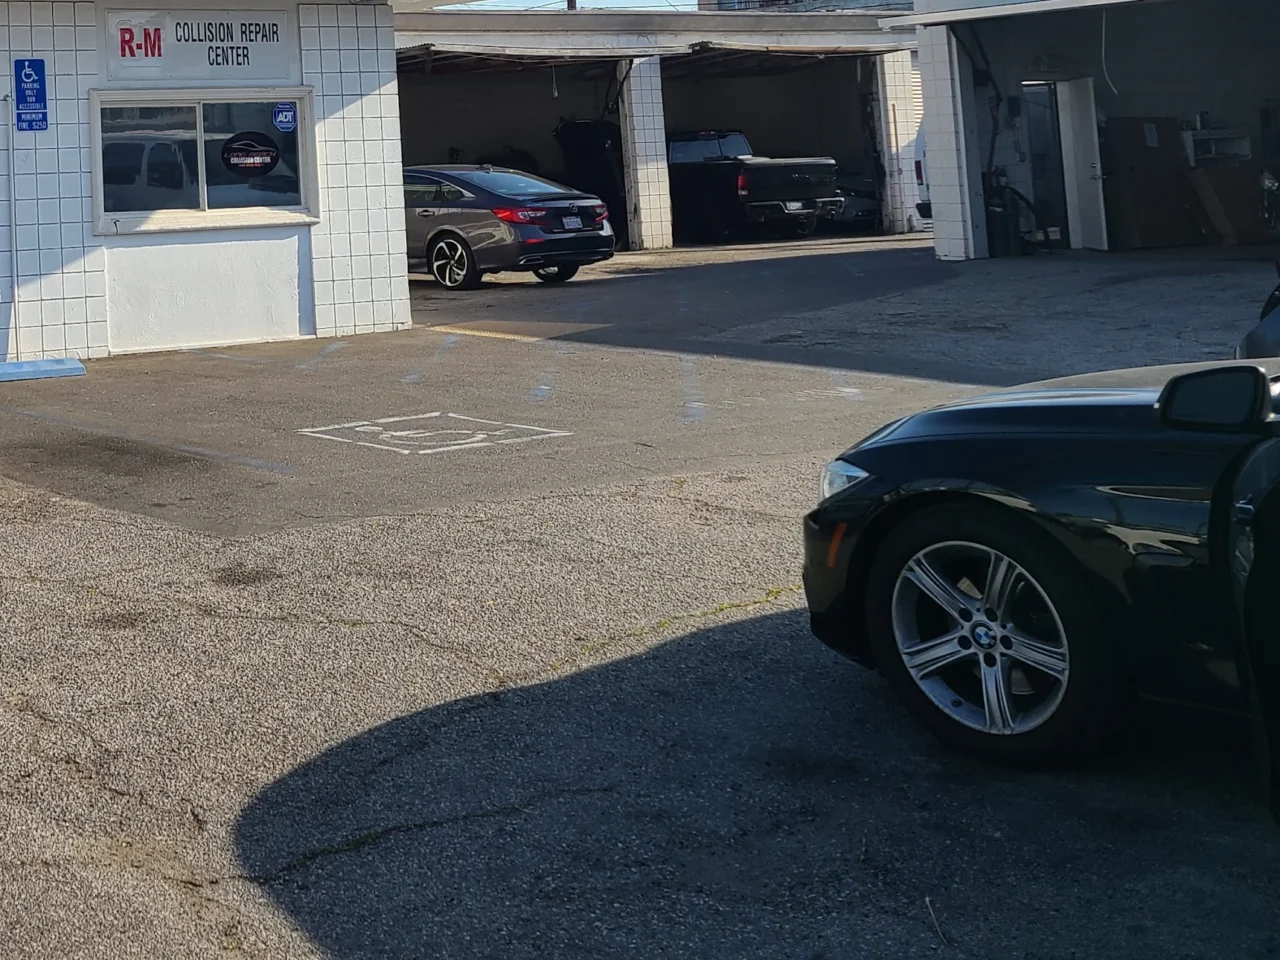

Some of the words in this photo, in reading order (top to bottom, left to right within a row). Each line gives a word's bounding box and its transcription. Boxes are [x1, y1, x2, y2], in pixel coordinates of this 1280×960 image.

[120, 27, 163, 58] R-M
[175, 22, 234, 43] COLLISION
[240, 22, 280, 43] REPAIR
[207, 45, 251, 66] CENTER
[277, 111, 294, 123] ADT
